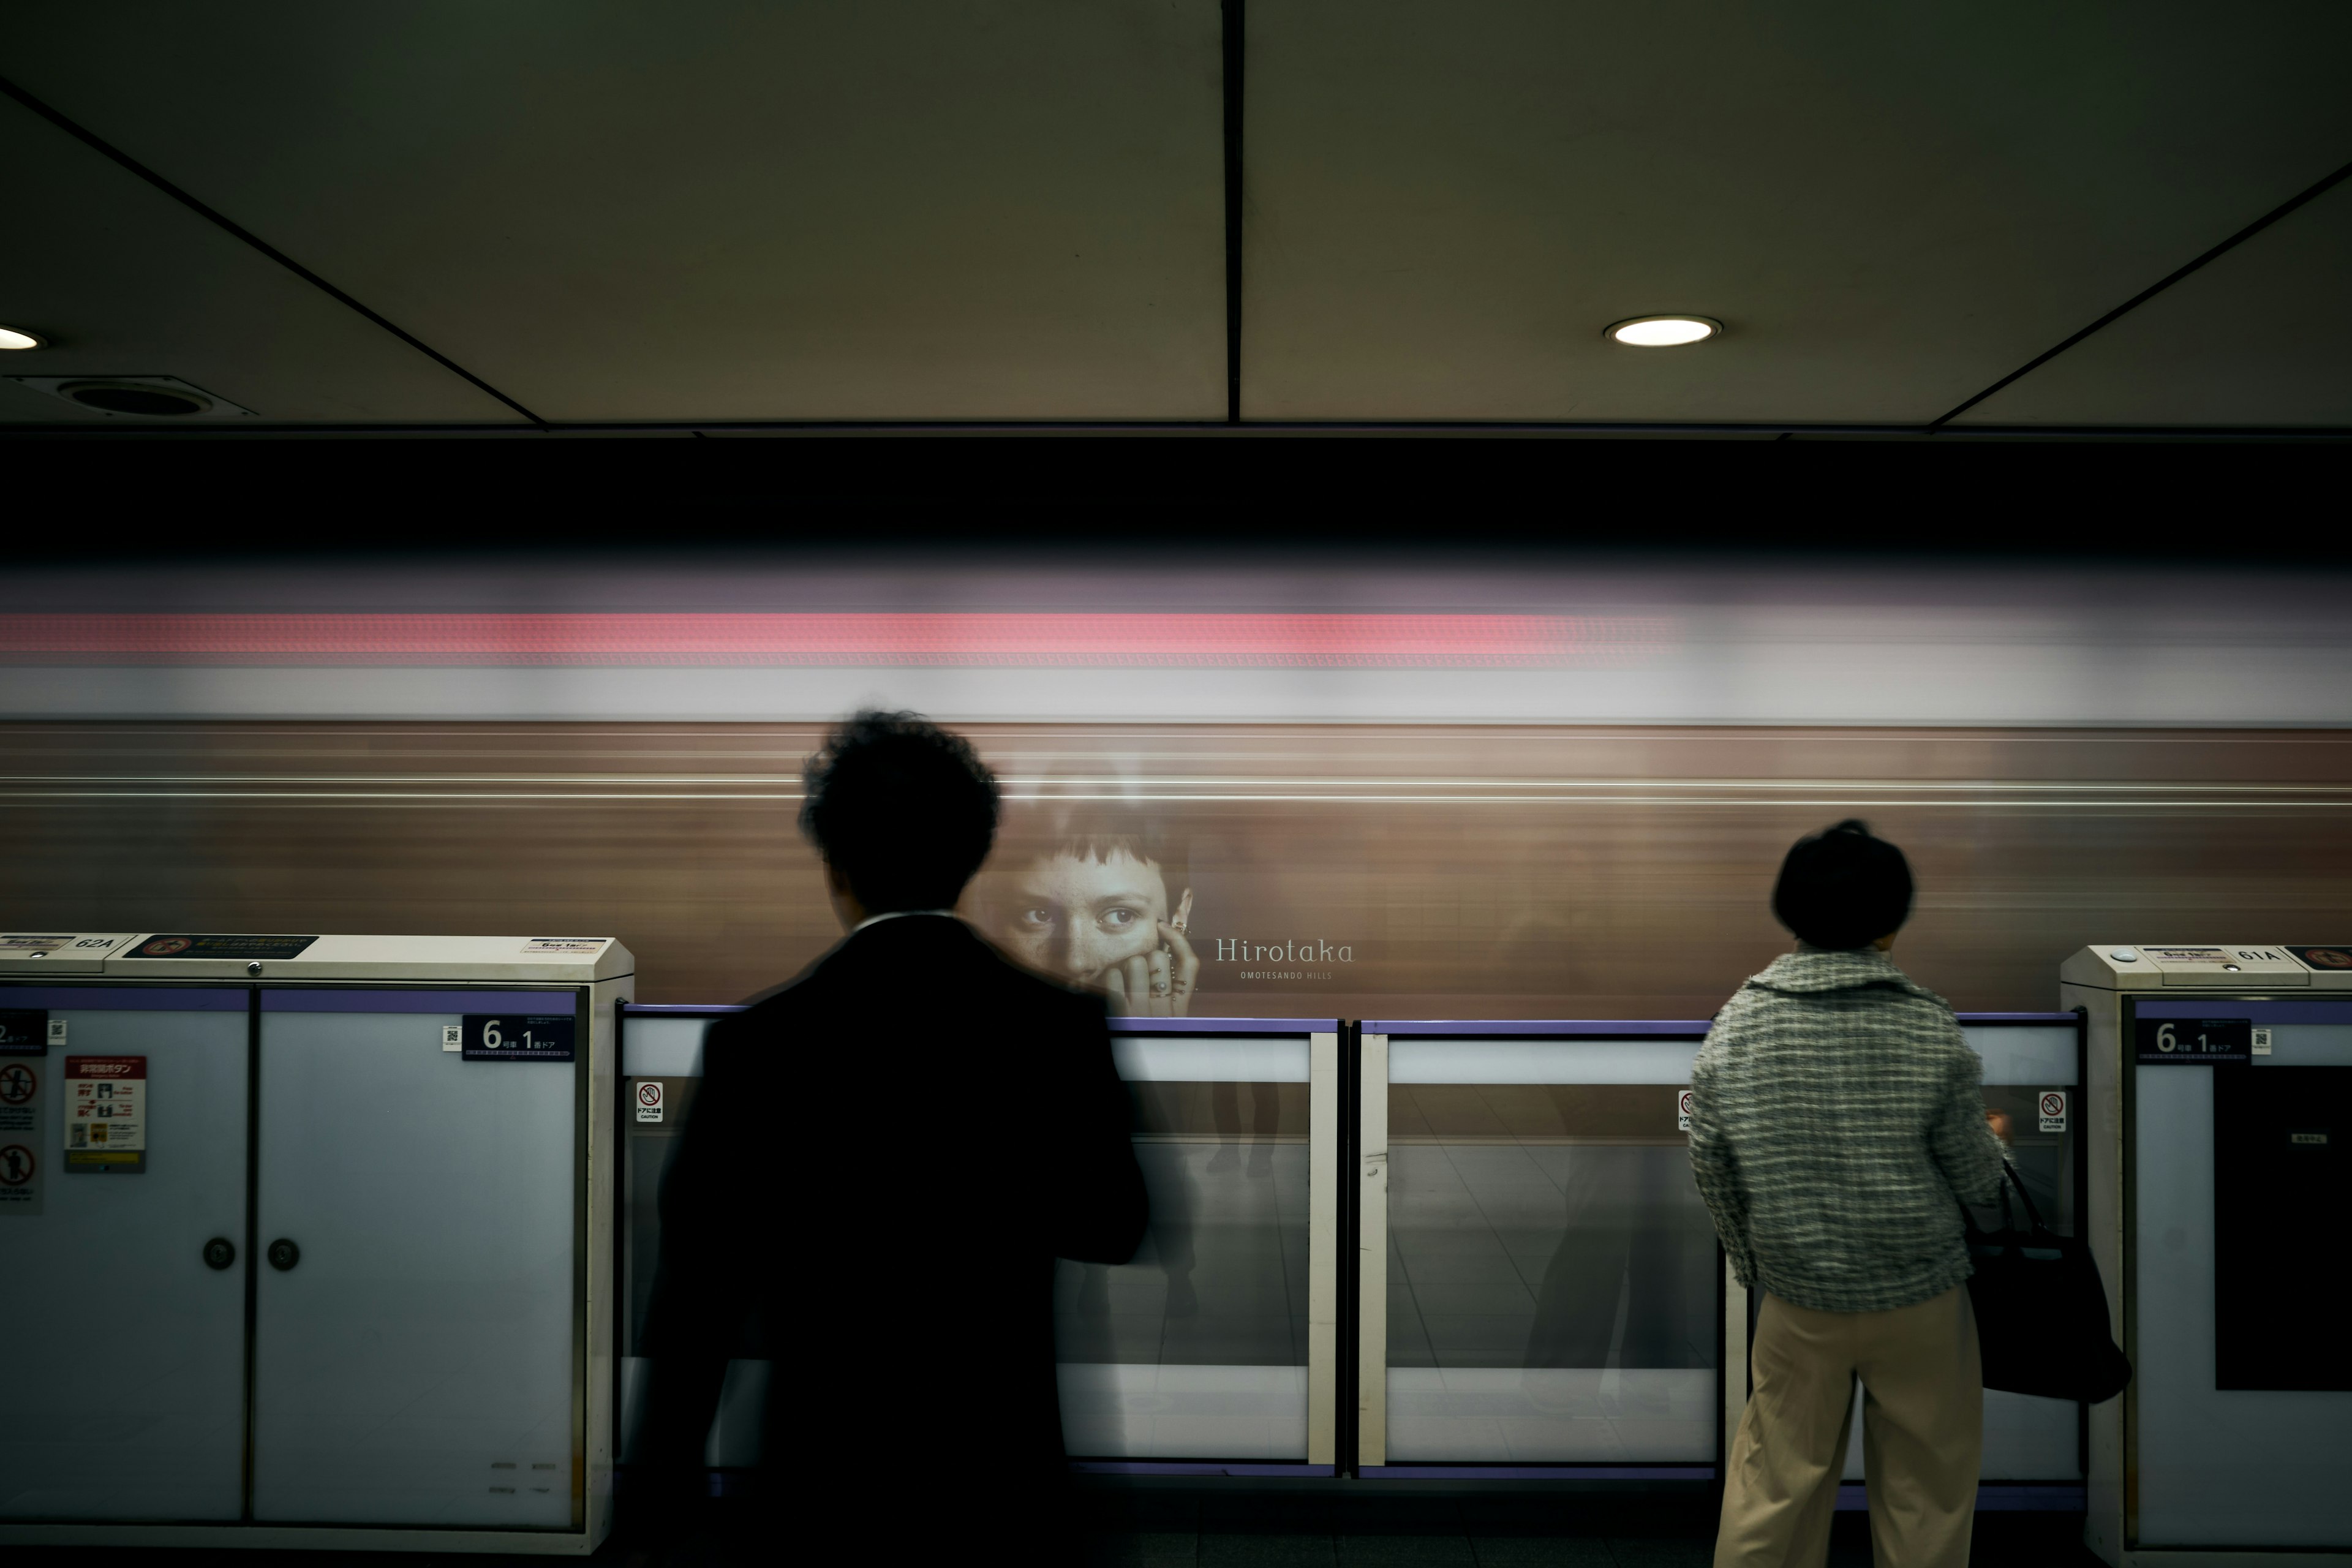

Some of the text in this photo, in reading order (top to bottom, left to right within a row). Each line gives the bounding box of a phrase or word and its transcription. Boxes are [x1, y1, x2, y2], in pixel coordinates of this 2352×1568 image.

[76, 939, 115, 948] 62A
[1215, 938, 1356, 962] Hirotaka
[2238, 951, 2281, 960] 61A
[1240, 971, 1332, 980] OMOTESANDO HILLS
[482, 1019, 556, 1049] 6号車 1番ドア
[2156, 1022, 2231, 1053] 6号車 1番ドア
